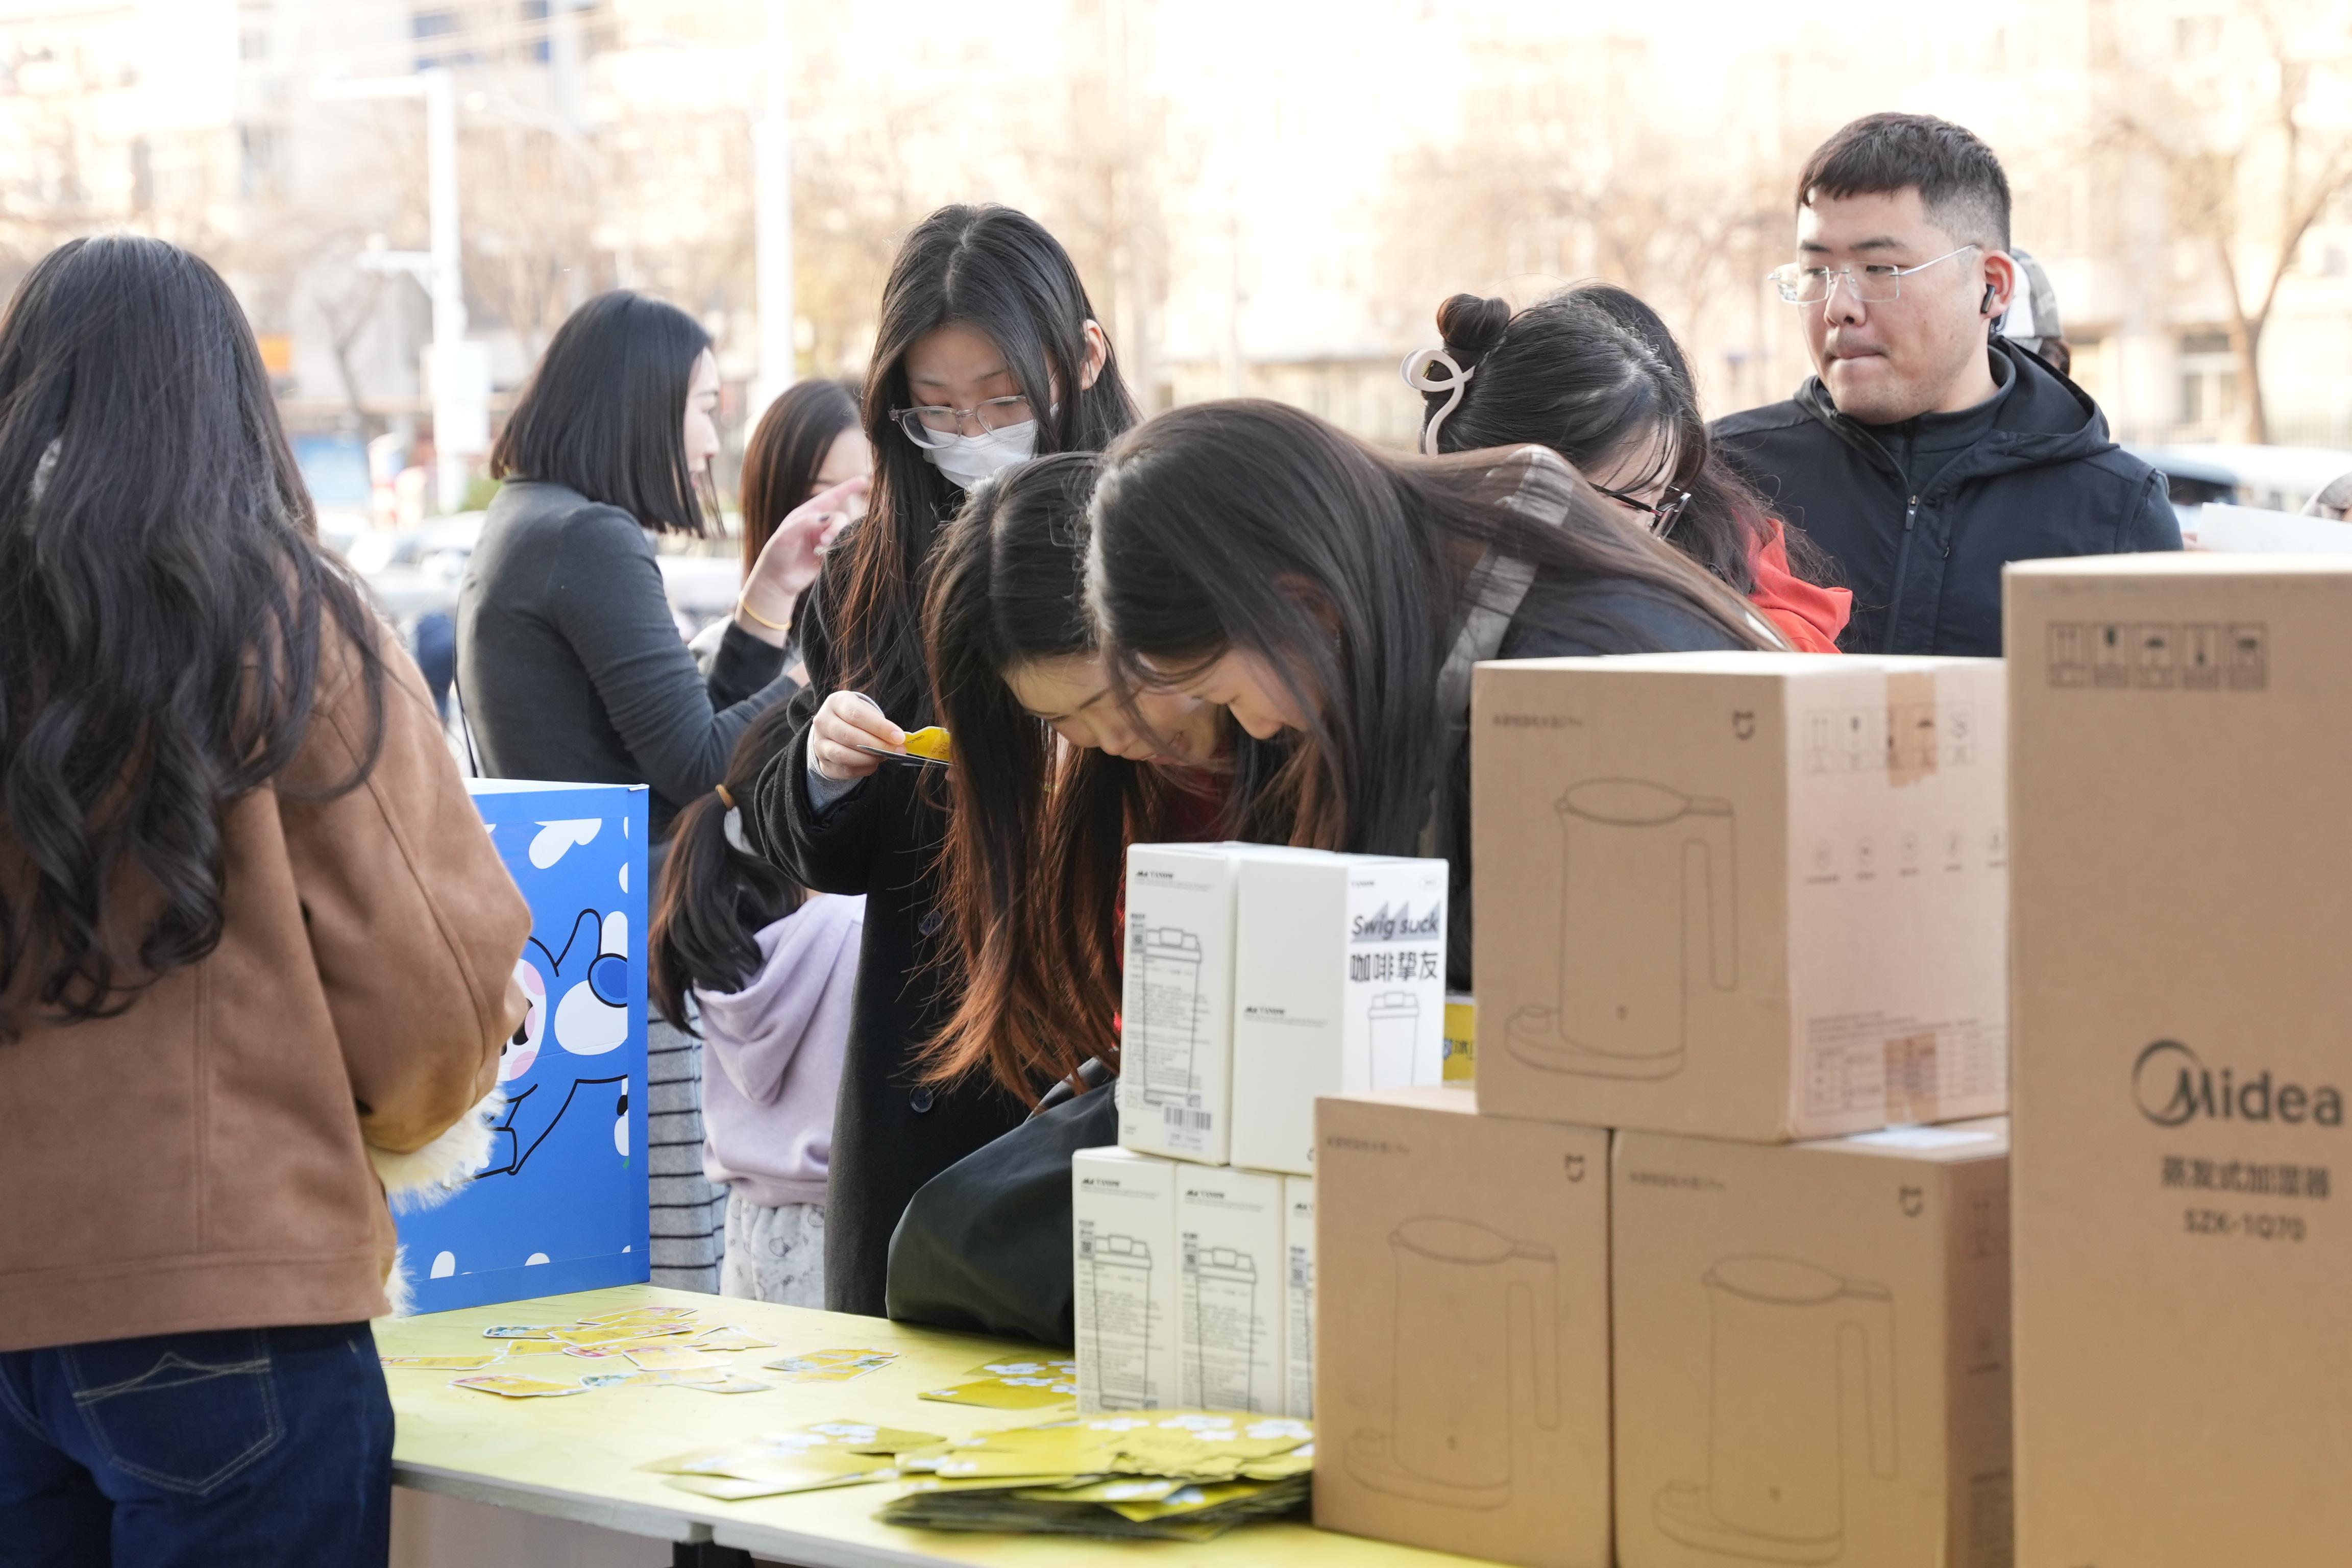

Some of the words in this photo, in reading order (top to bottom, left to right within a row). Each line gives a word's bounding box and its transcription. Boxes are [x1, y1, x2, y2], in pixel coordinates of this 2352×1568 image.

[1352, 914, 1395, 941] Swig
[1399, 911, 1438, 934] suck
[1351, 951, 1438, 981] 咖啡挚友
[2132, 1039, 2344, 1126] Midea
[2161, 1156, 2332, 1199] 蒸发式加湿器
